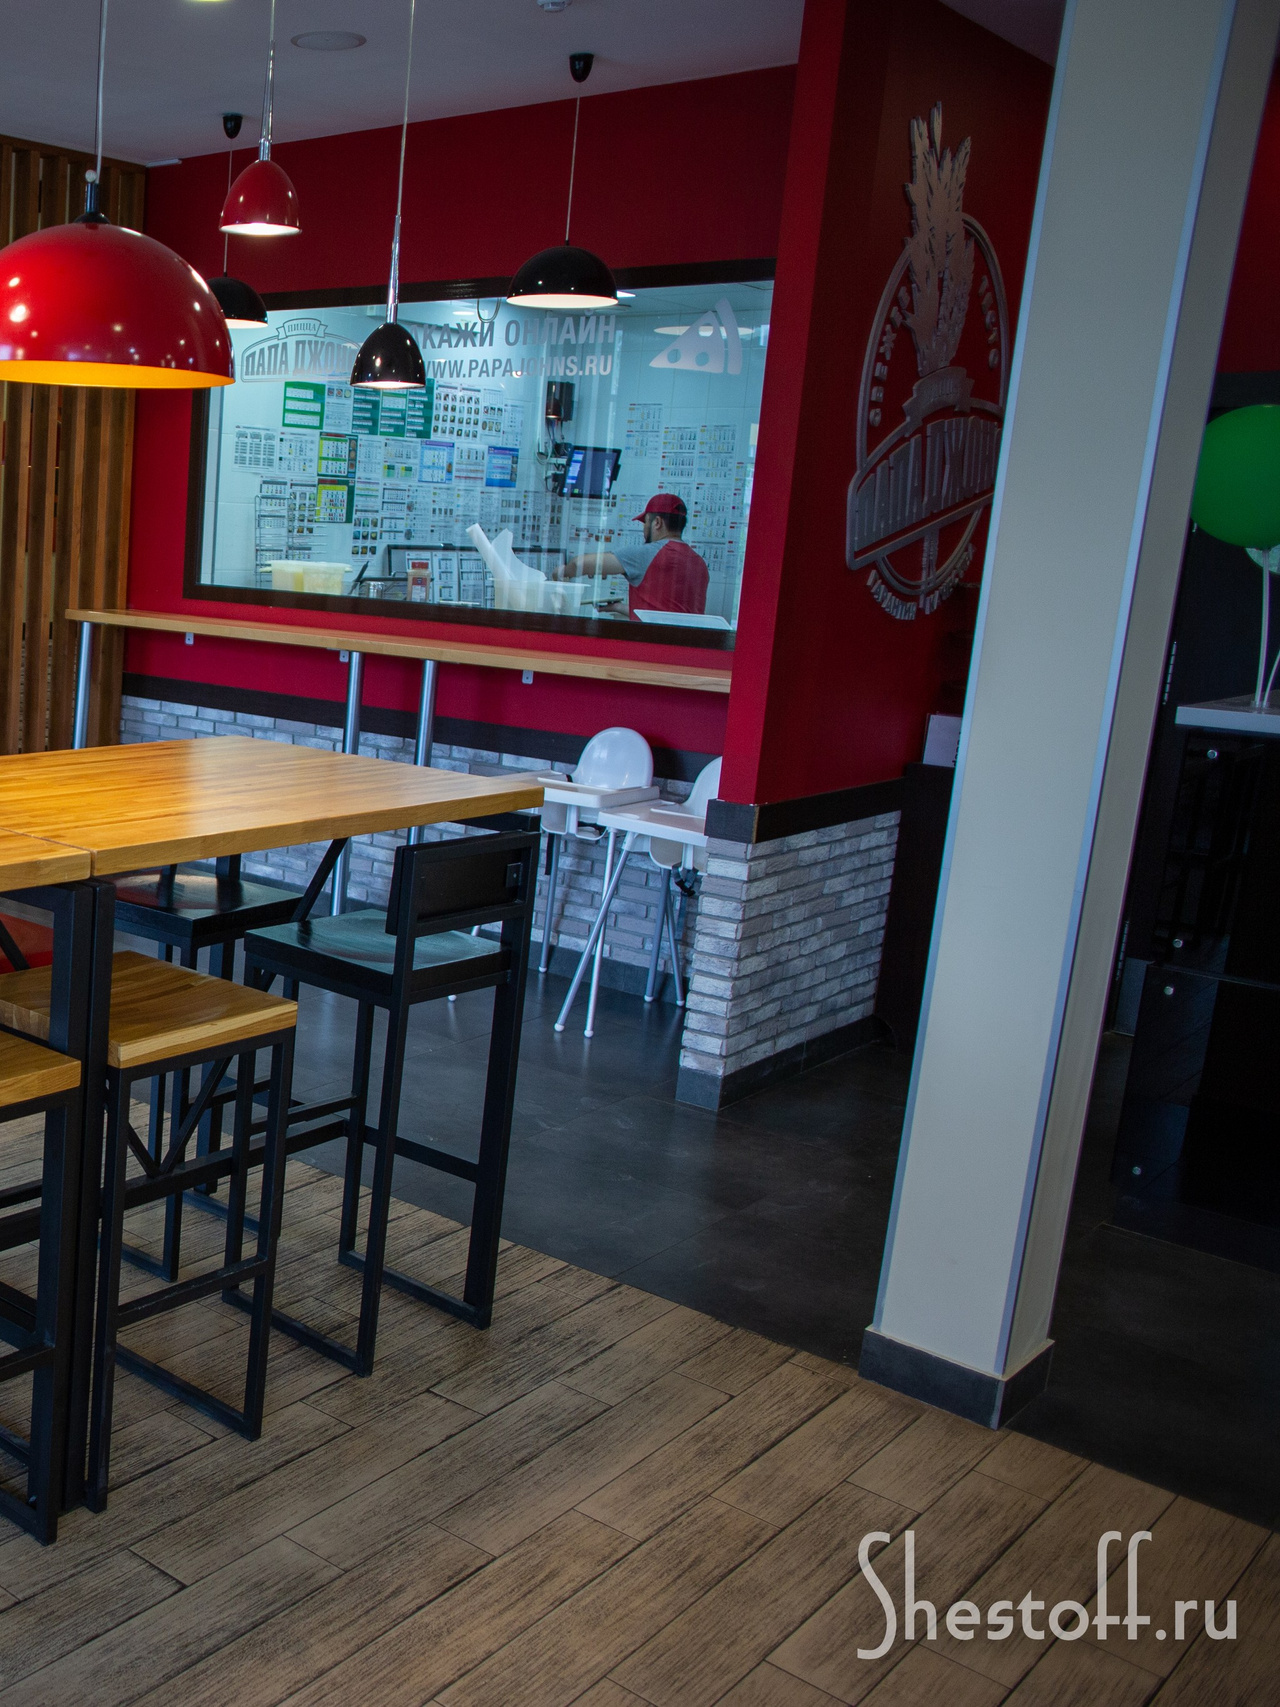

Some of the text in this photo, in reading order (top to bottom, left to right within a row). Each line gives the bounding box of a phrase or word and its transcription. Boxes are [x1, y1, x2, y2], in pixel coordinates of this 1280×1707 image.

[505, 310, 616, 347] ОНЛАЙН
[245, 341, 289, 376] ПАПА
[854, 434, 922, 552] ПАПА
